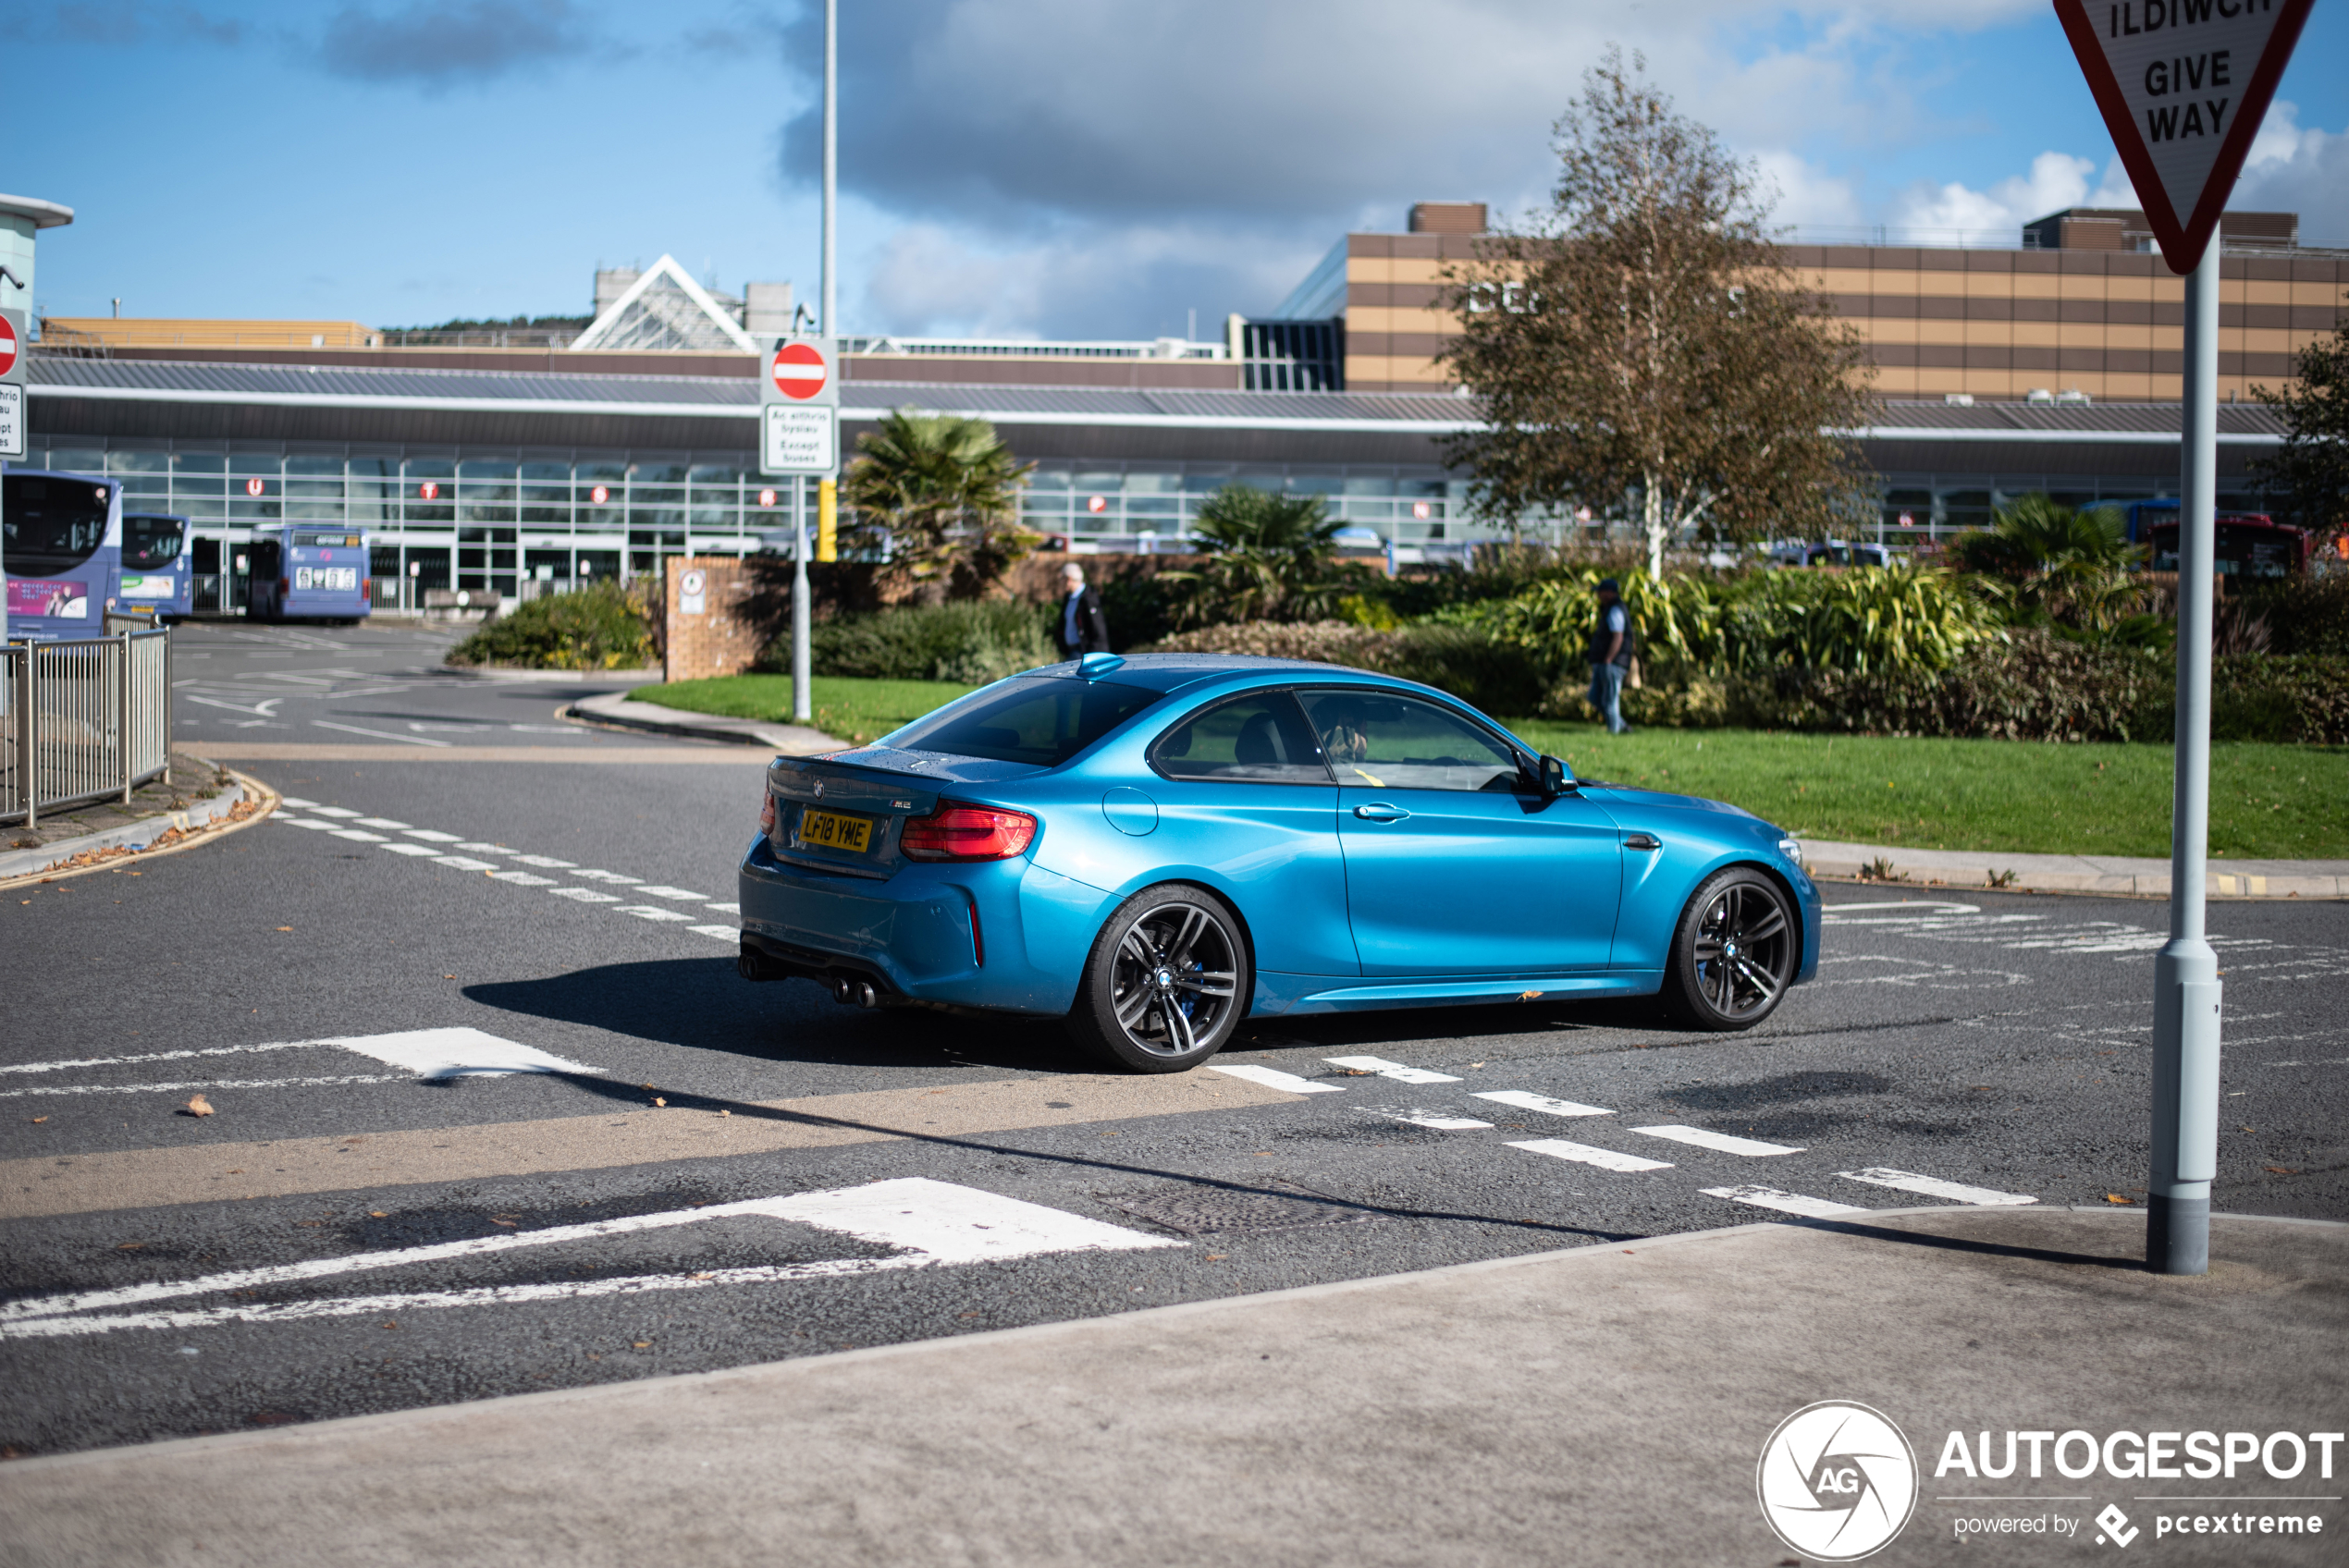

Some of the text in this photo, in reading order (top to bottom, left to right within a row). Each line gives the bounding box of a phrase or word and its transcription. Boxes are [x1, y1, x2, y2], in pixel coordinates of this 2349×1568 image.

[2146, 50, 2231, 97] GIVE
[2147, 98, 2229, 142] WAY
[781, 439, 819, 451] Except
[783, 453, 816, 463] buses
[249, 478, 262, 496] U
[423, 482, 437, 500] T
[894, 800, 912, 809] M2
[837, 819, 867, 848] YME
